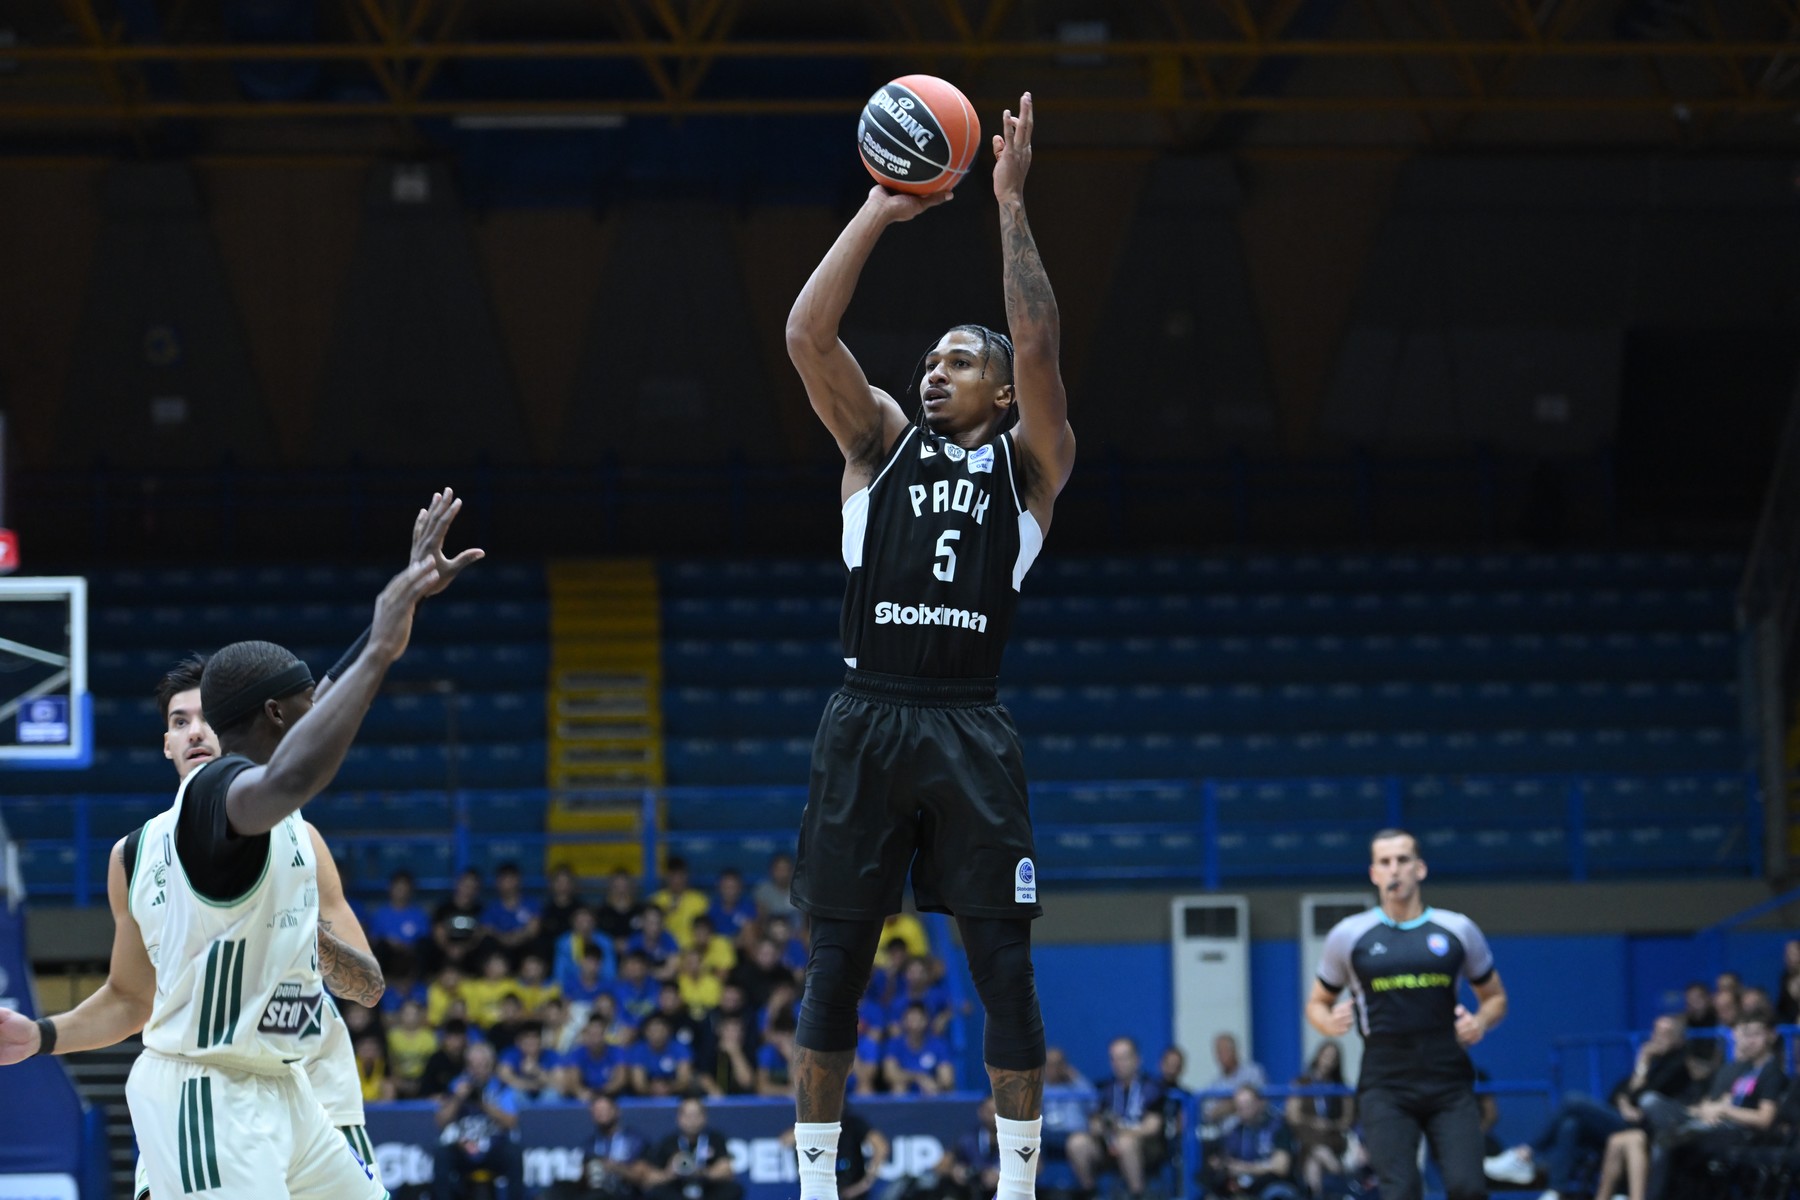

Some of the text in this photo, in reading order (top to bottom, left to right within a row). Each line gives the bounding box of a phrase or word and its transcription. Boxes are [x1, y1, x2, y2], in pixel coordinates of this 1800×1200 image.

[886, 162, 909, 176] CUP
[908, 478, 991, 525] PAOK
[932, 529, 961, 583] 5
